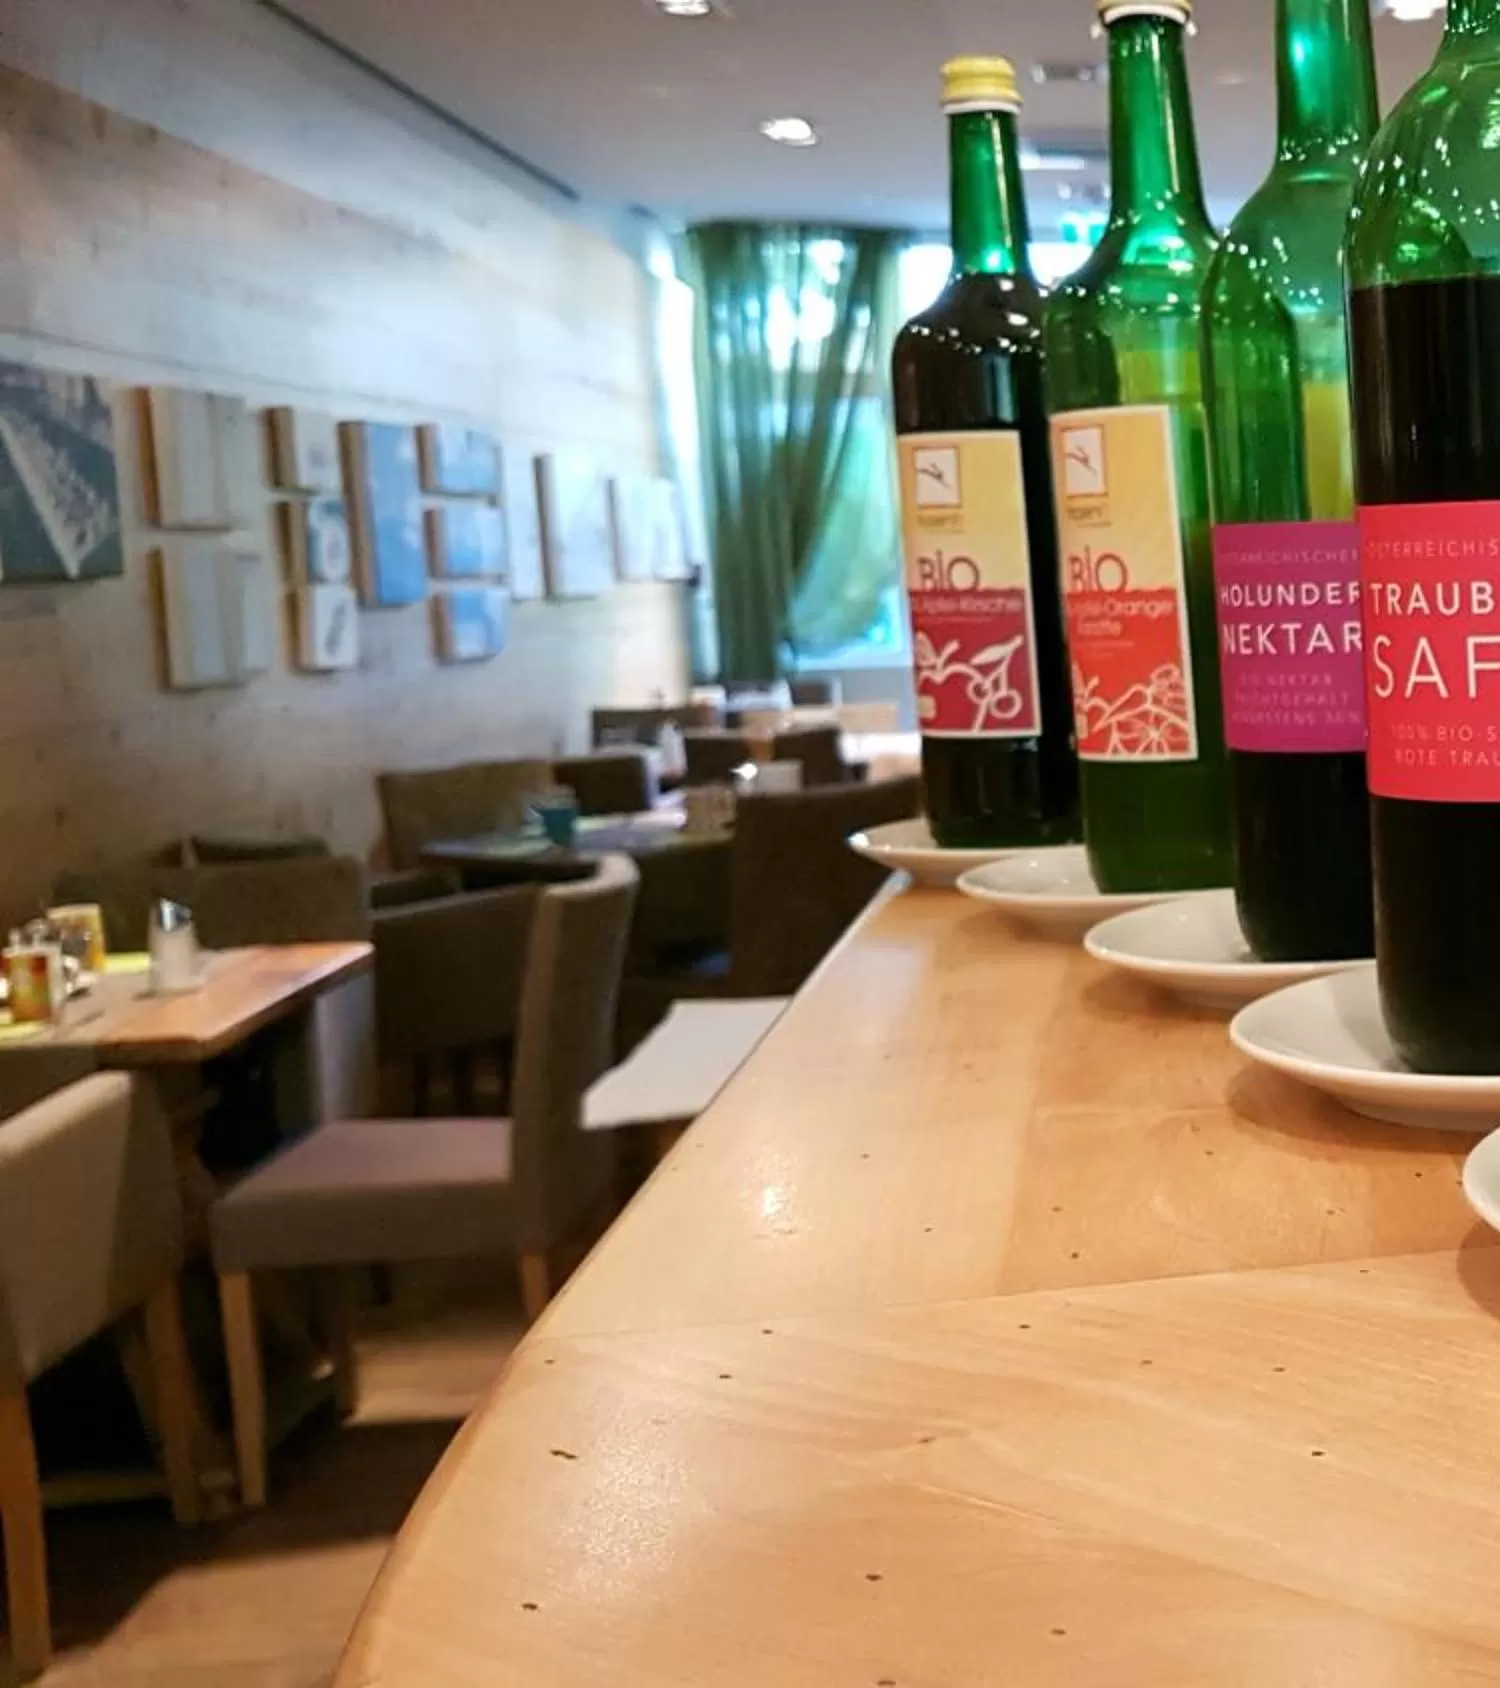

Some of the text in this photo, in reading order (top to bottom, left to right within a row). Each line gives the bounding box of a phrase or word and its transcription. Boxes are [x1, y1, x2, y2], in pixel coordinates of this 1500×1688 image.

[916, 548, 980, 592] BIO
[1067, 544, 1128, 592] BIO
[1220, 581, 1360, 607] HOLUNDER
[1222, 621, 1363, 655] NEKTAR
